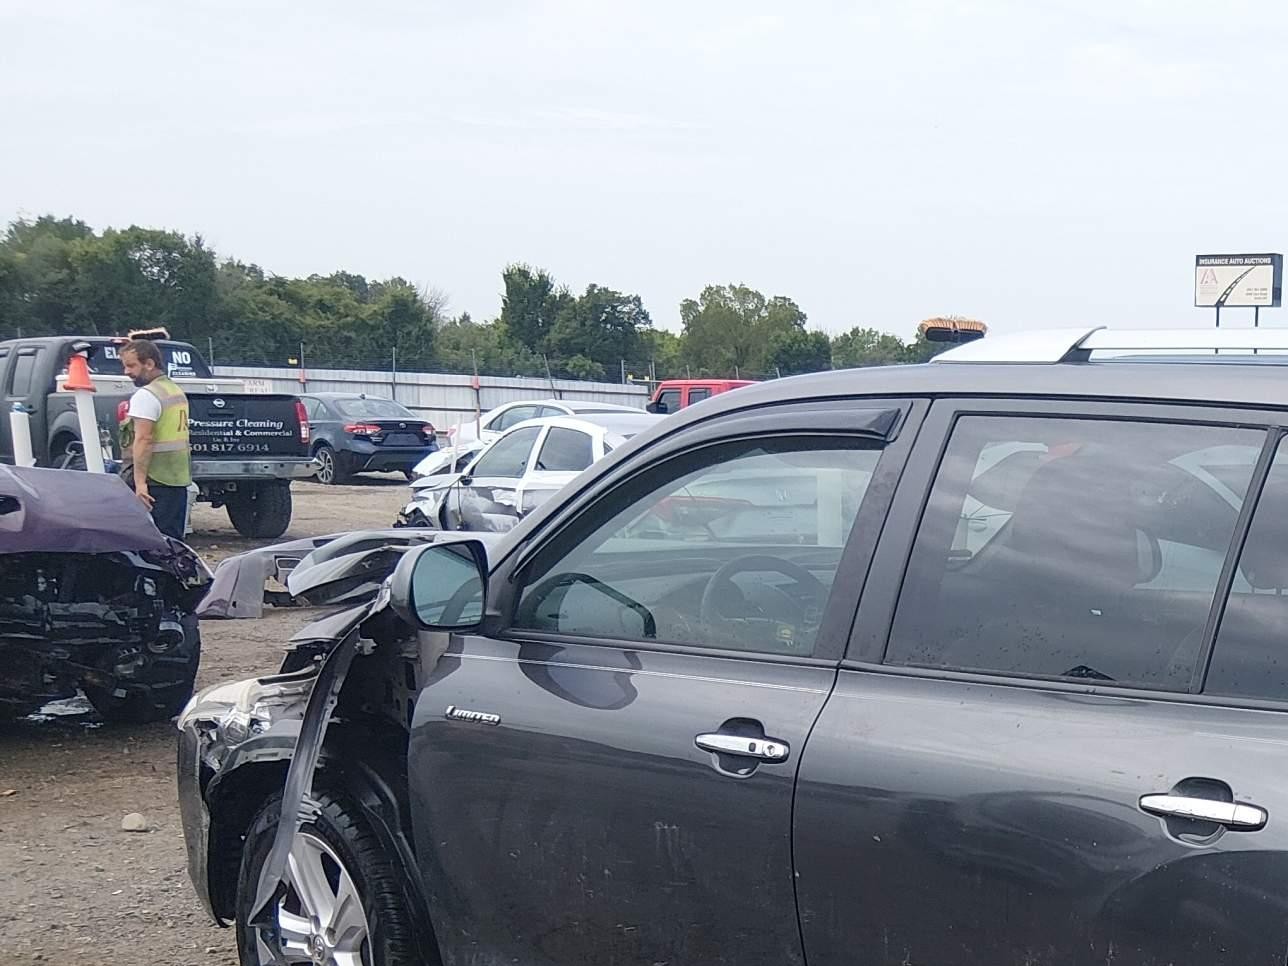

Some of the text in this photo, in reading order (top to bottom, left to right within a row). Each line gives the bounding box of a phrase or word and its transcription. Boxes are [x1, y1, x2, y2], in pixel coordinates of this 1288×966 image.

[1229, 257, 1244, 265] AUTO
[187, 418, 234, 427] Pressure
[236, 418, 284, 430] Cleaning
[211, 443, 234, 451] 817
[237, 443, 270, 451] 6914
